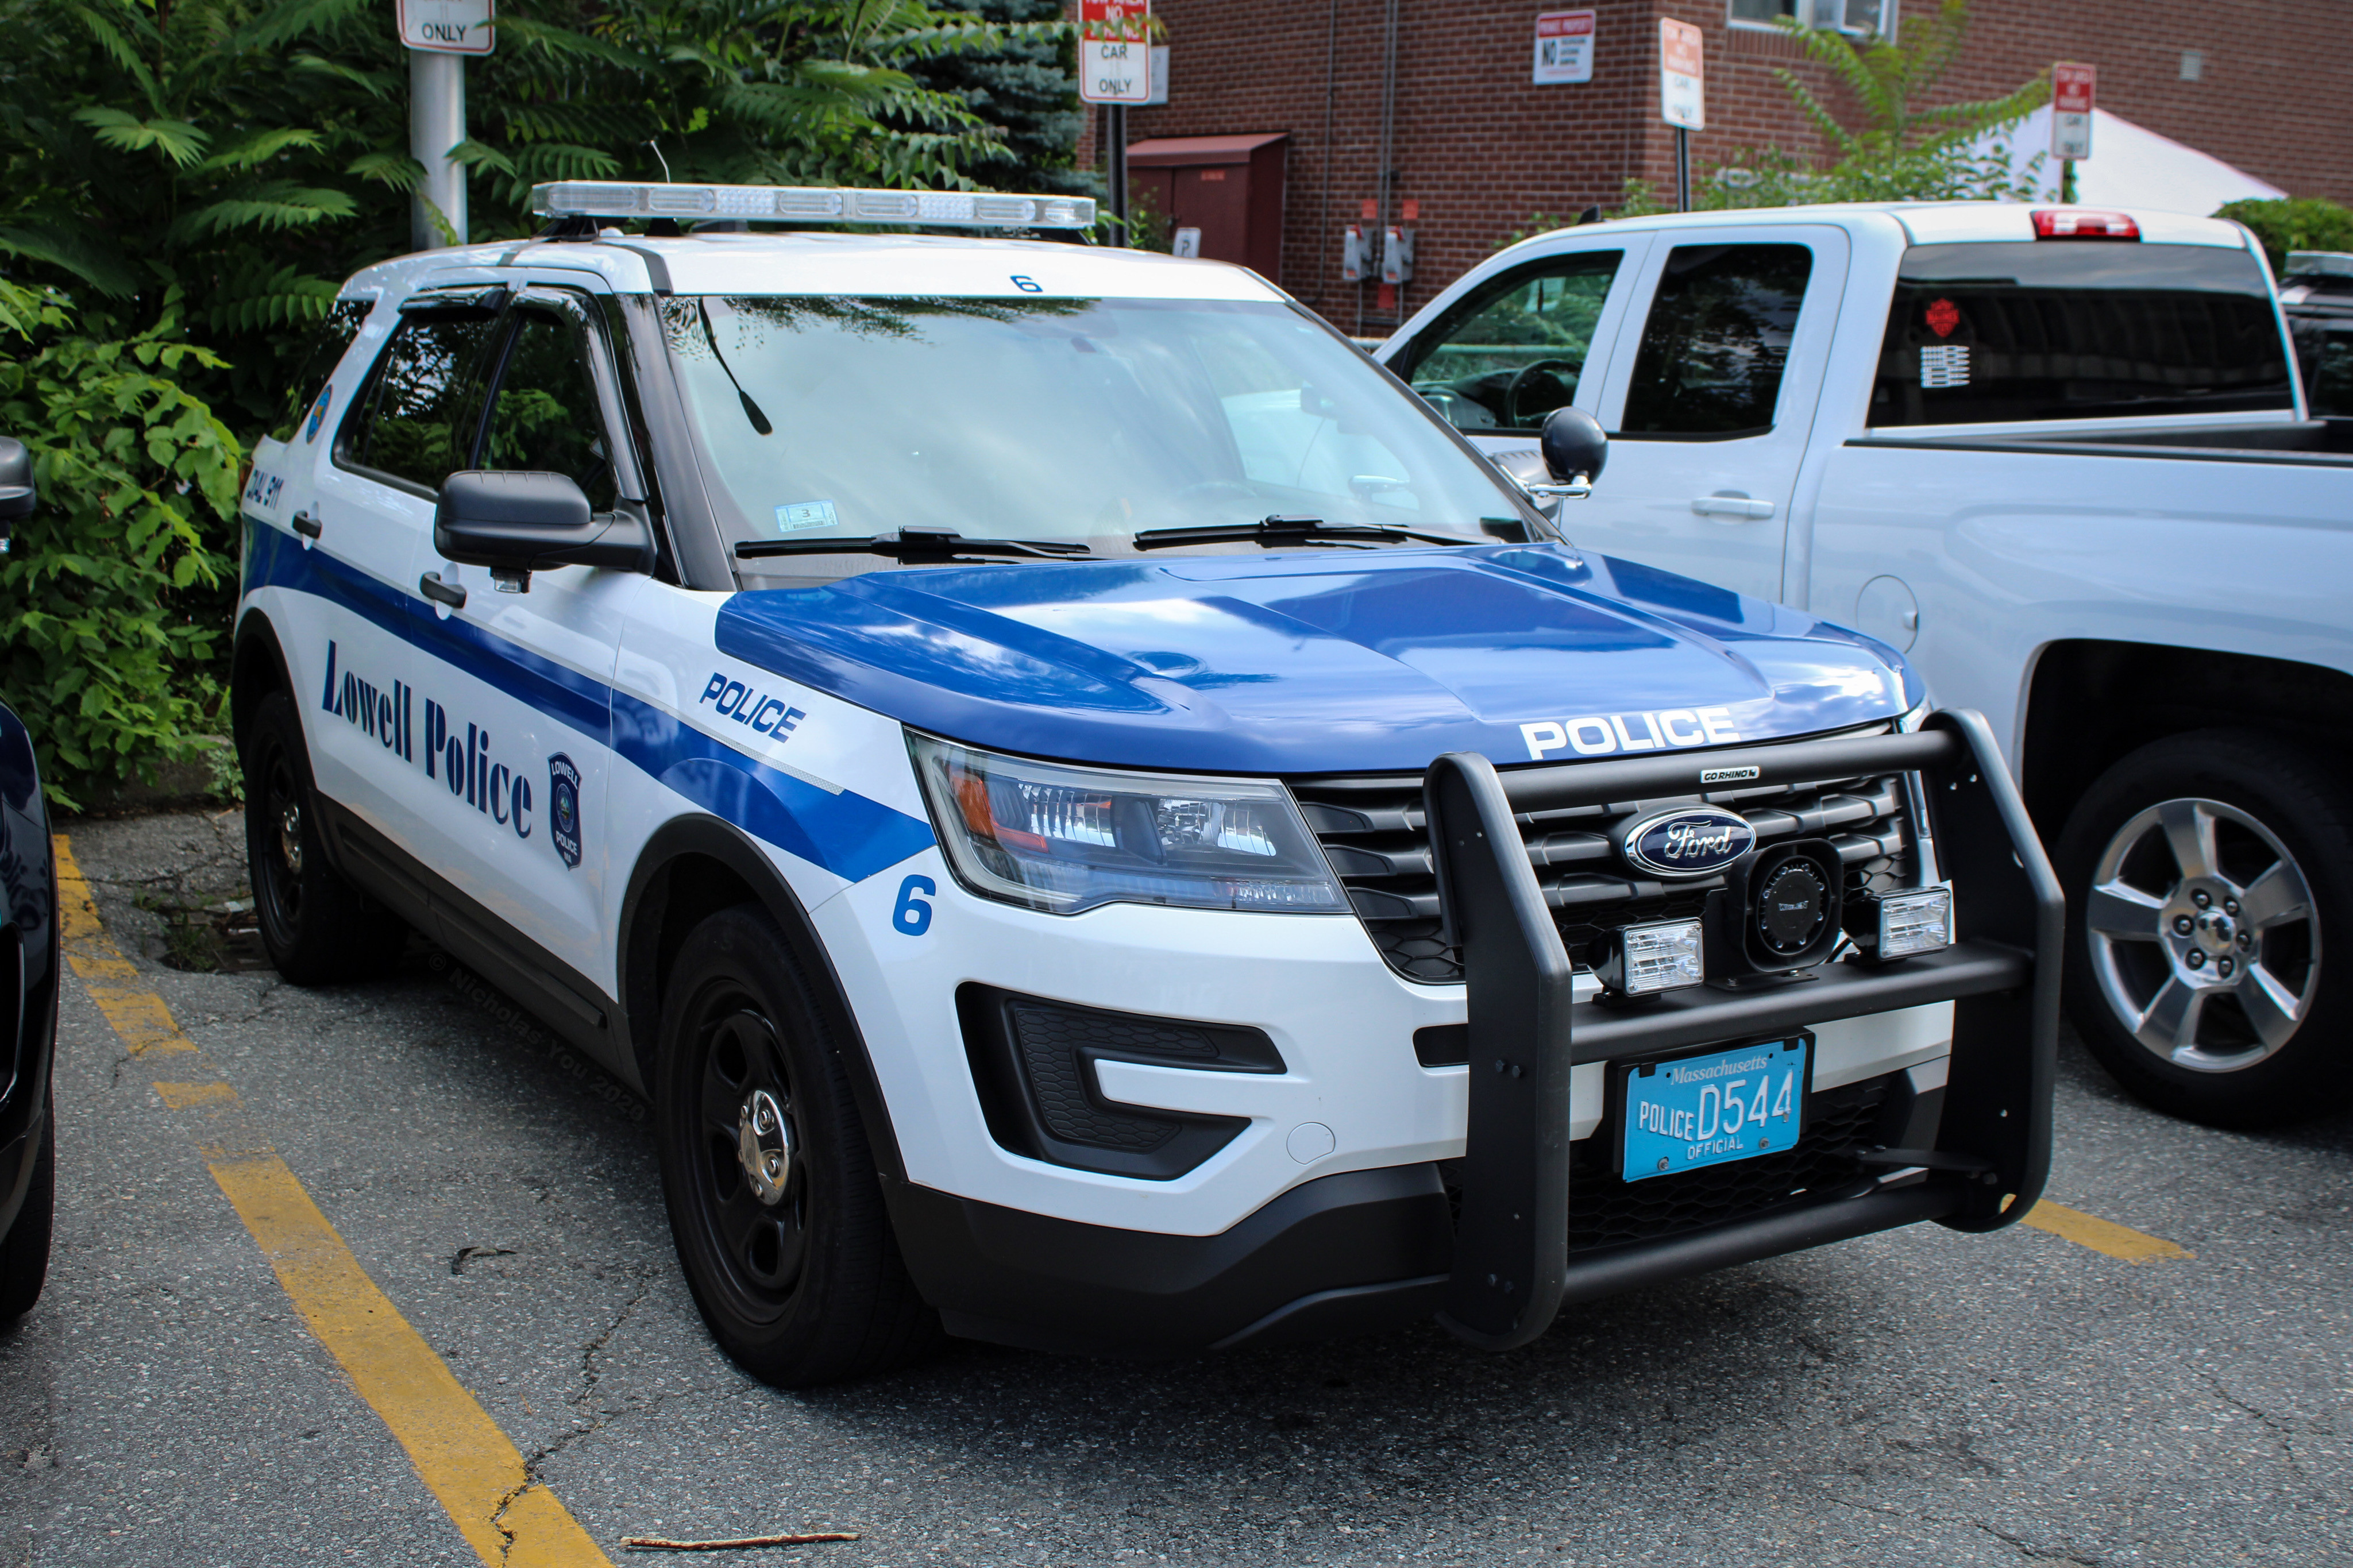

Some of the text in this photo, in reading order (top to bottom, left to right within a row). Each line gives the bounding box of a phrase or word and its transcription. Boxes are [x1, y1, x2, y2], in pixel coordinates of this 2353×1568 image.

[422, 22, 466, 42] ONLY
[1101, 45, 1128, 59] CAR
[1542, 40, 1557, 67] NO
[1099, 78, 1132, 94] ONLY
[1009, 275, 1044, 292] 6
[264, 476, 283, 509] 911
[801, 509, 811, 518] 3
[699, 672, 807, 744] POLICE
[322, 640, 532, 839] Lowell Police
[1519, 707, 1741, 760] POLICE
[551, 760, 578, 790] LOWELL
[556, 830, 578, 856] POLICE
[1664, 820, 1733, 859] Ford
[564, 851, 572, 864] MA
[892, 874, 937, 937] 6
[1671, 1056, 1768, 1086] Massachusetts
[1638, 1069, 1793, 1142] POLICE D544
[1687, 1136, 1744, 1160] OFFICIAL
